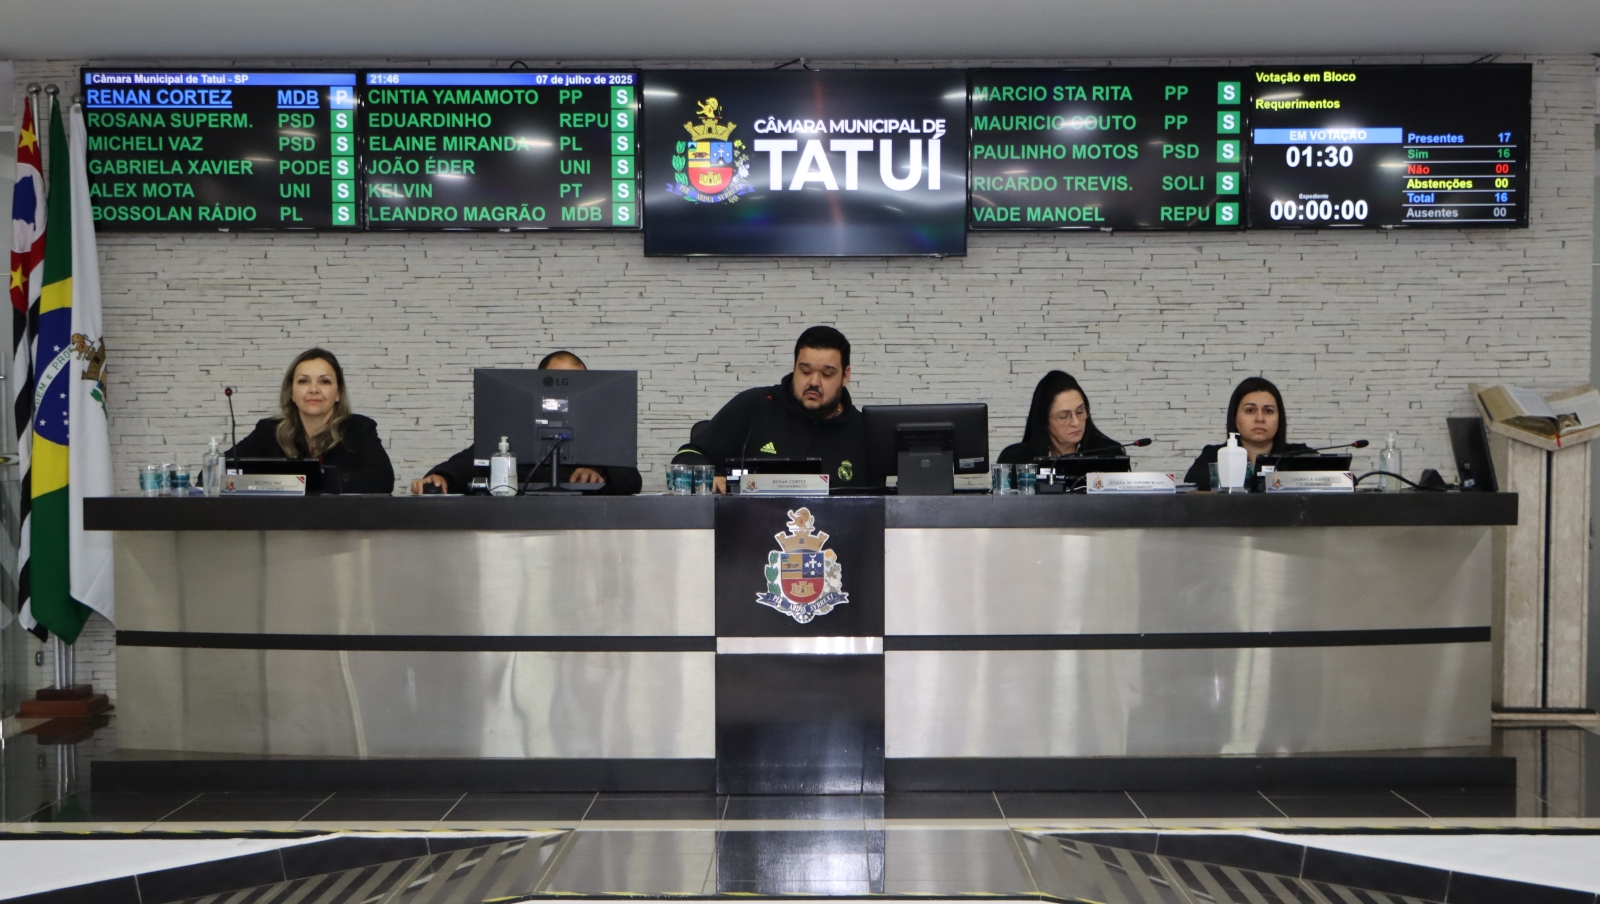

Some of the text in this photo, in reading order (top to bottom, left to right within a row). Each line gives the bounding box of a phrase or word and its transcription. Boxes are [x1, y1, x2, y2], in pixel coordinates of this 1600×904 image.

[93, 74, 132, 83] Câmara
[135, 74, 183, 85] Municipal
[186, 74, 198, 83] de
[234, 75, 248, 83] SP
[370, 75, 399, 84] 21:46
[536, 75, 633, 85] 07 de julho de 2025
[1256, 72, 1356, 84] Votação em Bloco
[87, 89, 232, 104] RENAN CORTEZ
[278, 90, 319, 104] MDB
[336, 90, 348, 104] P
[368, 89, 539, 105] CINTIA YAMAMOTO
[559, 89, 582, 104] PP
[616, 90, 629, 105] S
[974, 86, 1132, 101] MARCIO STA RITA
[1165, 86, 1188, 100] PP
[1223, 86, 1235, 100] S
[1256, 99, 1340, 112] Requerimentos
[88, 113, 253, 128] ROSANA SUPERM.
[278, 113, 315, 128] PSD
[335, 114, 348, 128] S
[369, 113, 491, 128] EDUARDINHO
[560, 113, 609, 128] REPU
[617, 113, 629, 128] S
[754, 116, 946, 134] CÂMARA MUNICIPAL DE
[974, 115, 1064, 130] MAURICIO
[1165, 115, 1188, 129] PP
[1223, 115, 1235, 129] S
[1290, 128, 1367, 142] EM VOTAÇÃO
[1408, 133, 1464, 145] Presentes
[1498, 132, 1511, 142] 17
[89, 136, 203, 151] MICHELI VAZ
[279, 137, 315, 151] PSD
[336, 137, 348, 151] S
[369, 137, 529, 151] ELAINE MIRANDA
[560, 137, 582, 151] PL
[617, 137, 629, 151] S
[974, 144, 1139, 159] PAULINHO MOTOS
[1163, 144, 1199, 159] PSD
[1222, 144, 1234, 158] S
[1286, 146, 1353, 167] 01:30
[1408, 149, 1428, 158] Sim
[1498, 149, 1510, 158] 16
[89, 160, 253, 174] GABRIELA XAVIER
[279, 161, 330, 175] PODE
[336, 160, 349, 175] S
[368, 156, 475, 175] JOÃO ÉDER
[560, 160, 590, 174] UNI
[617, 160, 629, 175] S
[754, 132, 946, 191] TATUÍ
[1496, 164, 1509, 173] 00
[1408, 165, 1430, 174] Não
[679, 185, 690, 194] PER
[974, 176, 1133, 191] RICARDO TREVIS.
[1162, 176, 1204, 190] SOLI
[1221, 176, 1233, 190] S
[1407, 178, 1472, 190] Abstenções
[1495, 178, 1509, 188] 00
[90, 183, 195, 198] ALEX MOTA
[280, 184, 310, 198] UNI
[337, 184, 350, 198] S
[368, 184, 432, 198] KELVIN
[560, 184, 582, 198] PT
[617, 184, 629, 198] S
[1495, 193, 1508, 202] 16
[1407, 193, 1434, 203] Total
[92, 203, 256, 221] BOSSOLAN RÁDIO
[280, 207, 303, 220] PL
[338, 206, 350, 221] S
[368, 205, 546, 222] LEANDRO MAGRÃO
[561, 207, 602, 221] MDB
[618, 207, 630, 222] S
[973, 207, 1104, 221] VADE MANOEL
[1161, 206, 1210, 220] REPU
[1221, 206, 1233, 221] S
[1270, 200, 1368, 220] 00:00:00
[1406, 208, 1458, 217] Ausentes
[1494, 207, 1506, 217] 00
[556, 378, 568, 386] LG
[773, 595, 783, 603] PER
